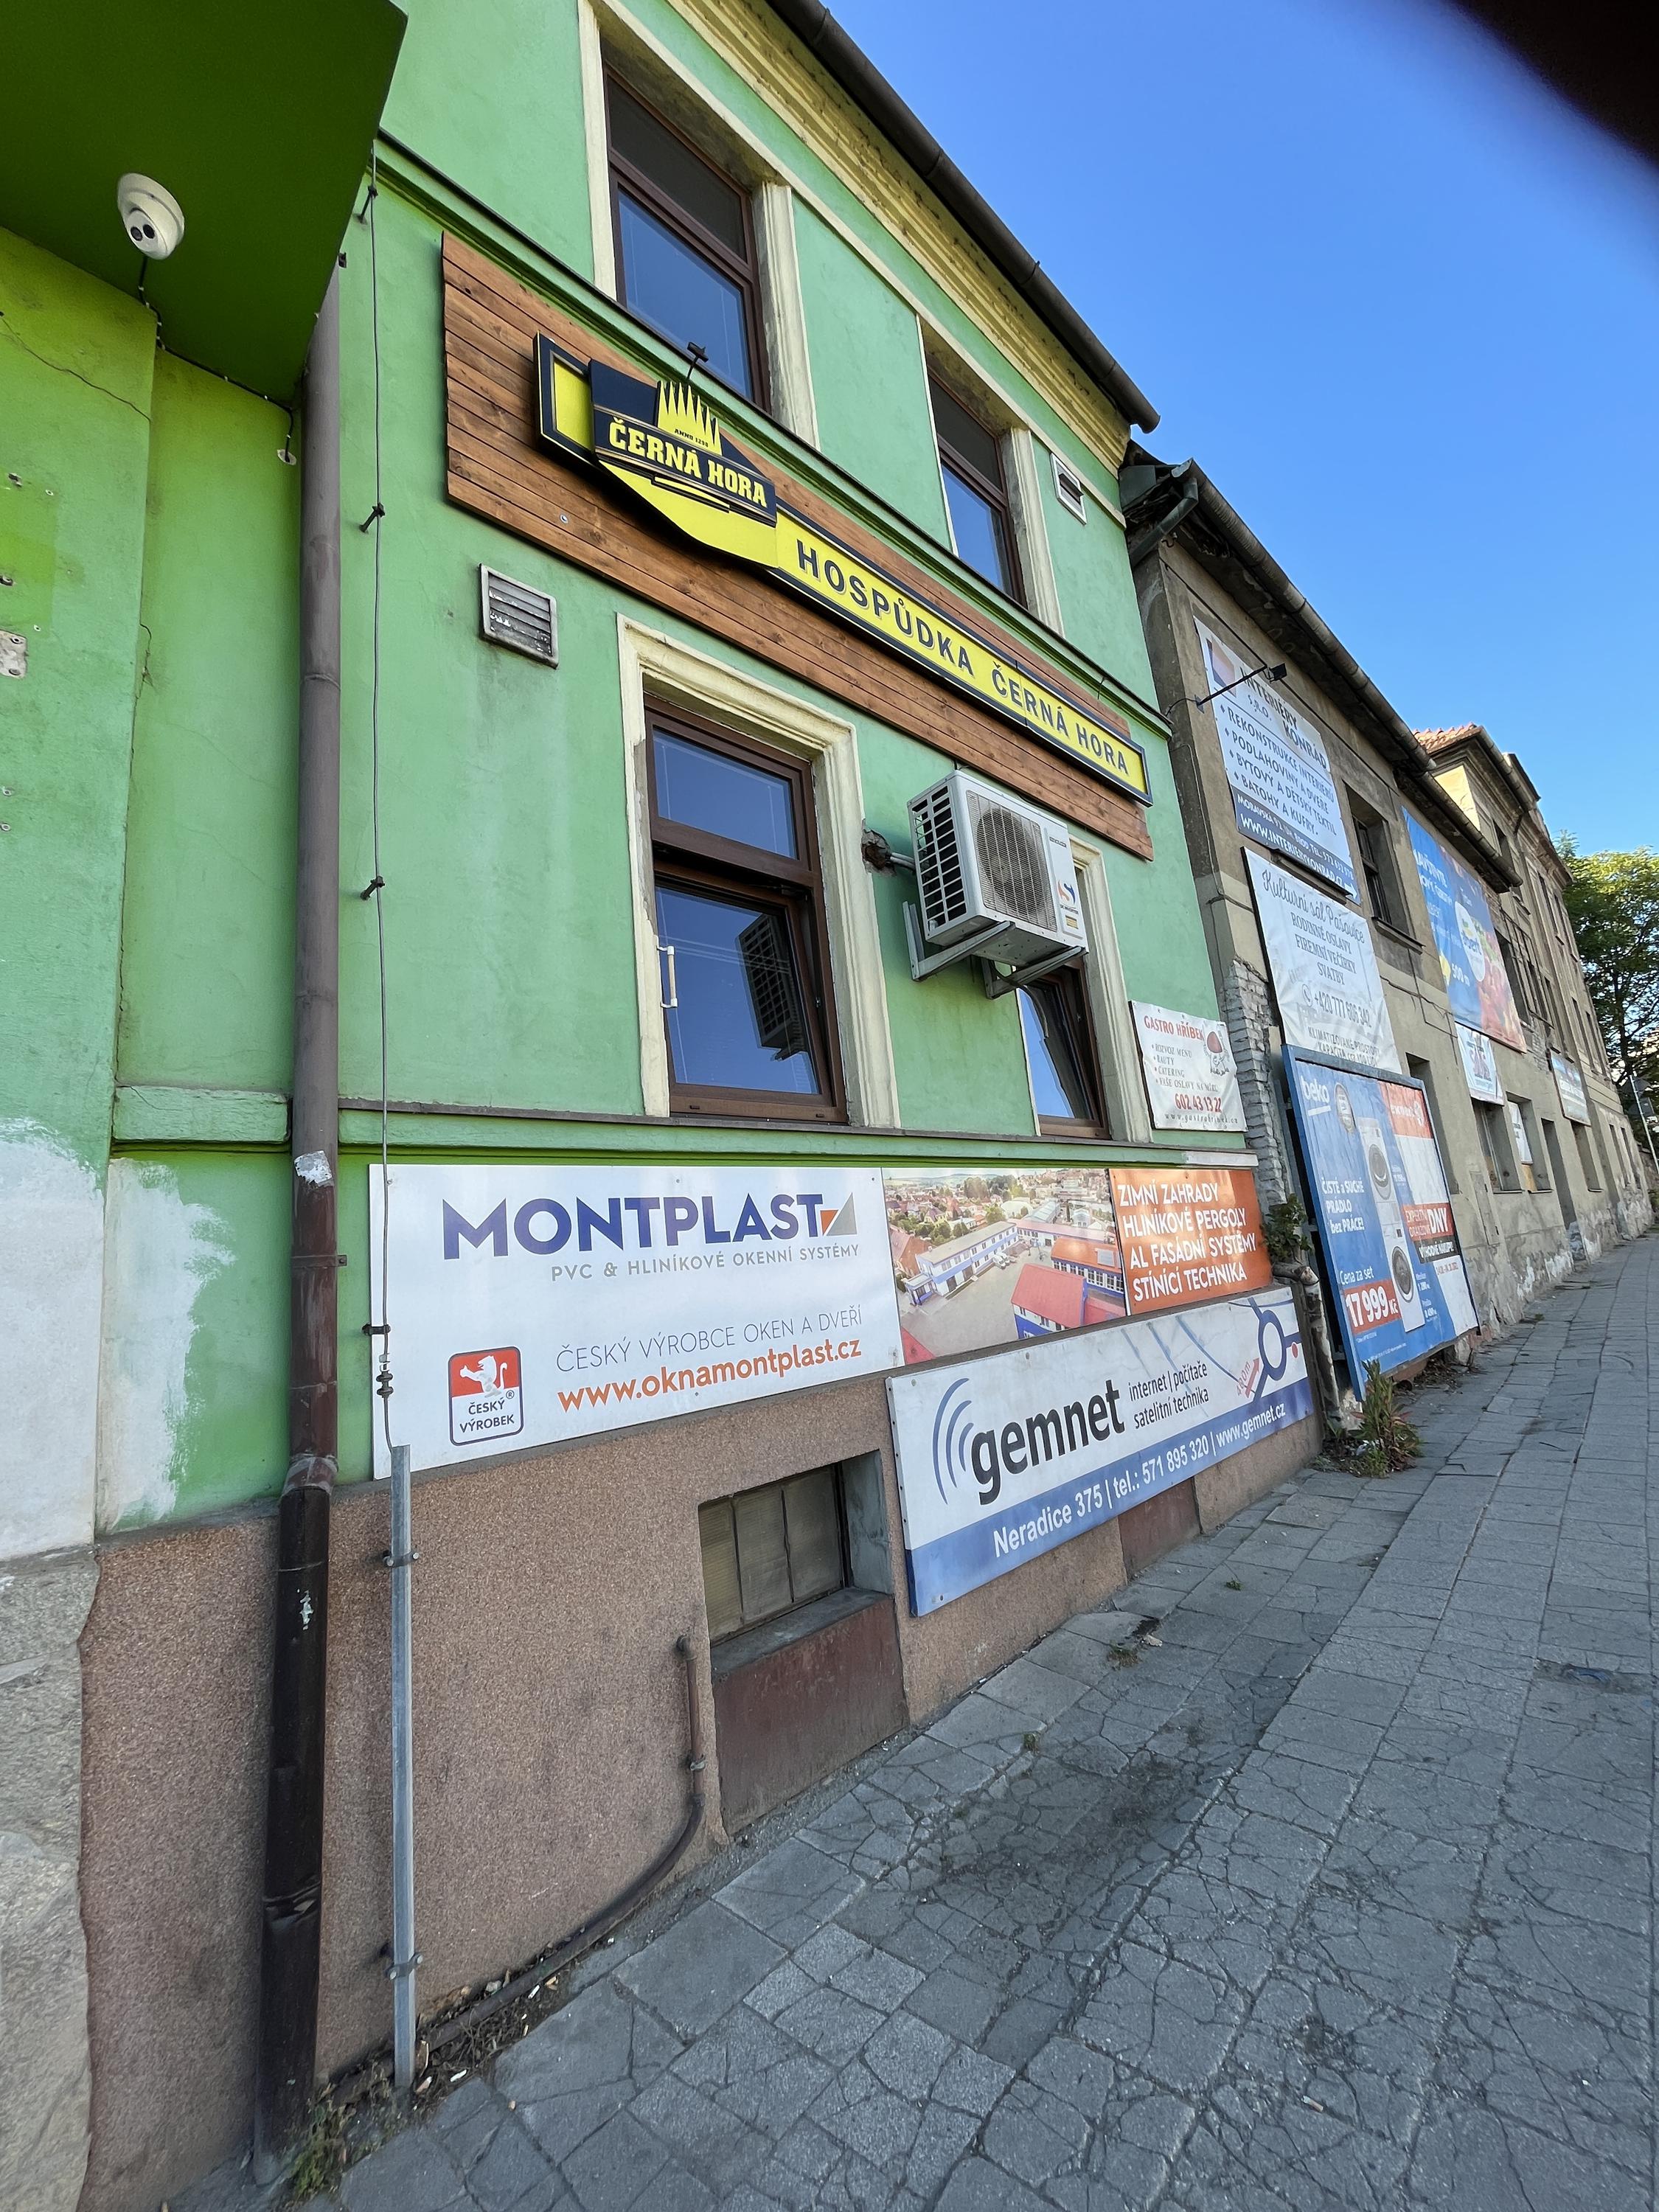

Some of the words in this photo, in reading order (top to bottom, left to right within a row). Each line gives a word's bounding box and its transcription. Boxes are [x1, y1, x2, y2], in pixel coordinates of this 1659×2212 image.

[675, 428, 693, 440] ANNO
[609, 417, 701, 479] ČERNÁ
[709, 461, 768, 507] HORA
[796, 538, 975, 676] HOSPŮDKA
[992, 661, 1068, 737] ČERNÁ
[1076, 723, 1130, 775] HORA
[1228, 706, 1298, 772] REKONSTRUKCE
[1283, 720, 1326, 769] KONRÁD
[1232, 730, 1298, 787] PODLAHOVINY
[1236, 753, 1274, 787] BYTOVÝ
[1277, 782, 1284, 794] A
[1241, 774, 1279, 809] BATOHY
[1282, 803, 1289, 816] A
[1262, 869, 1309, 913] Kulturní
[1310, 901, 1326, 922] sál
[1290, 912, 1326, 941] RODINNÉ
[1326, 931, 1352, 954] OSLAVY
[1295, 933, 1328, 961] FIREMNÍ
[1317, 961, 1345, 985] SVATBY
[1314, 991, 1333, 1014] +420
[1332, 996, 1346, 1018] 777
[1144, 1015, 1174, 1034] GASTRO
[1176, 1021, 1205, 1040] HŘÍBEK
[1155, 1043, 1175, 1054] ROZVOZ
[1157, 1054, 1174, 1065] RAUTY
[1158, 1066, 1185, 1078] CATERING
[1159, 1077, 1172, 1087] VAŠE
[1174, 1079, 1194, 1090] OSLAVY
[1300, 1075, 1330, 1104] beko
[1175, 1093, 1192, 1110] 602
[1192, 1095, 1203, 1111] 43
[1203, 1096, 1213, 1112] 13
[1214, 1097, 1222, 1113] 22
[1117, 1178, 1158, 1206] ZIMNÍ
[1161, 1182, 1219, 1204] ZAHRADY
[1321, 1176, 1340, 1194] ČISTÉ
[1344, 1177, 1365, 1193] SUCHÉ
[1122, 1206, 1194, 1237] HLINÍKOVÉ
[1195, 1208, 1247, 1230] PERGOLY
[1325, 1196, 1352, 1214] PRÁDLO
[1426, 1208, 1449, 1234] DNY
[442, 1192, 823, 1259] MONTPLAST
[1329, 1220, 1342, 1234] bez
[552, 1264, 592, 1281] PVC
[603, 1262, 618, 1277] &
[627, 1251, 725, 1275] HLINÍKOVÉ
[733, 1247, 793, 1266] OKENNÍ
[799, 1242, 859, 1261] SYSTÉMY
[1130, 1245, 1148, 1269] AL
[1151, 1234, 1206, 1266] FASÁDNÍ
[1208, 1230, 1256, 1257] SYSTÉMY
[1133, 1266, 1183, 1302] STÍNÍCÍ
[1183, 1262, 1248, 1290] TECHNIKA
[1340, 1270, 1355, 1285] Cena
[1355, 1270, 1363, 1281] za
[1363, 1266, 1374, 1279] set
[1345, 1293, 1364, 1327] 17
[1361, 1286, 1388, 1323] 999
[1388, 1298, 1399, 1315] Kč
[557, 1338, 631, 1372] ČESKÝ
[639, 1326, 736, 1357] VÝROBCE
[743, 1318, 794, 1343] OKEN
[801, 1316, 813, 1335] A
[818, 1304, 862, 1331] DVEŘÍ
[557, 1338, 862, 1413] www.oknamontplast.cz
[1128, 1374, 1167, 1402] internet
[1173, 1360, 1208, 1391] počítače
[459, 1413, 515, 1433] VÝROBEK
[468, 1397, 505, 1416] ČESKÝ
[1134, 1397, 1172, 1429] satelitní
[1173, 1386, 1209, 1413] technika
[971, 1379, 1124, 1506] gemnet
[993, 1504, 1072, 1558] Neradice
[1075, 1484, 1103, 1517] 375
[1113, 1470, 1140, 1499] tel.:
[1142, 1455, 1164, 1484] 571
[1166, 1444, 1188, 1472] 895
[1189, 1435, 1209, 1461] 320
[1216, 1402, 1286, 1447] www.gemnet.cz
